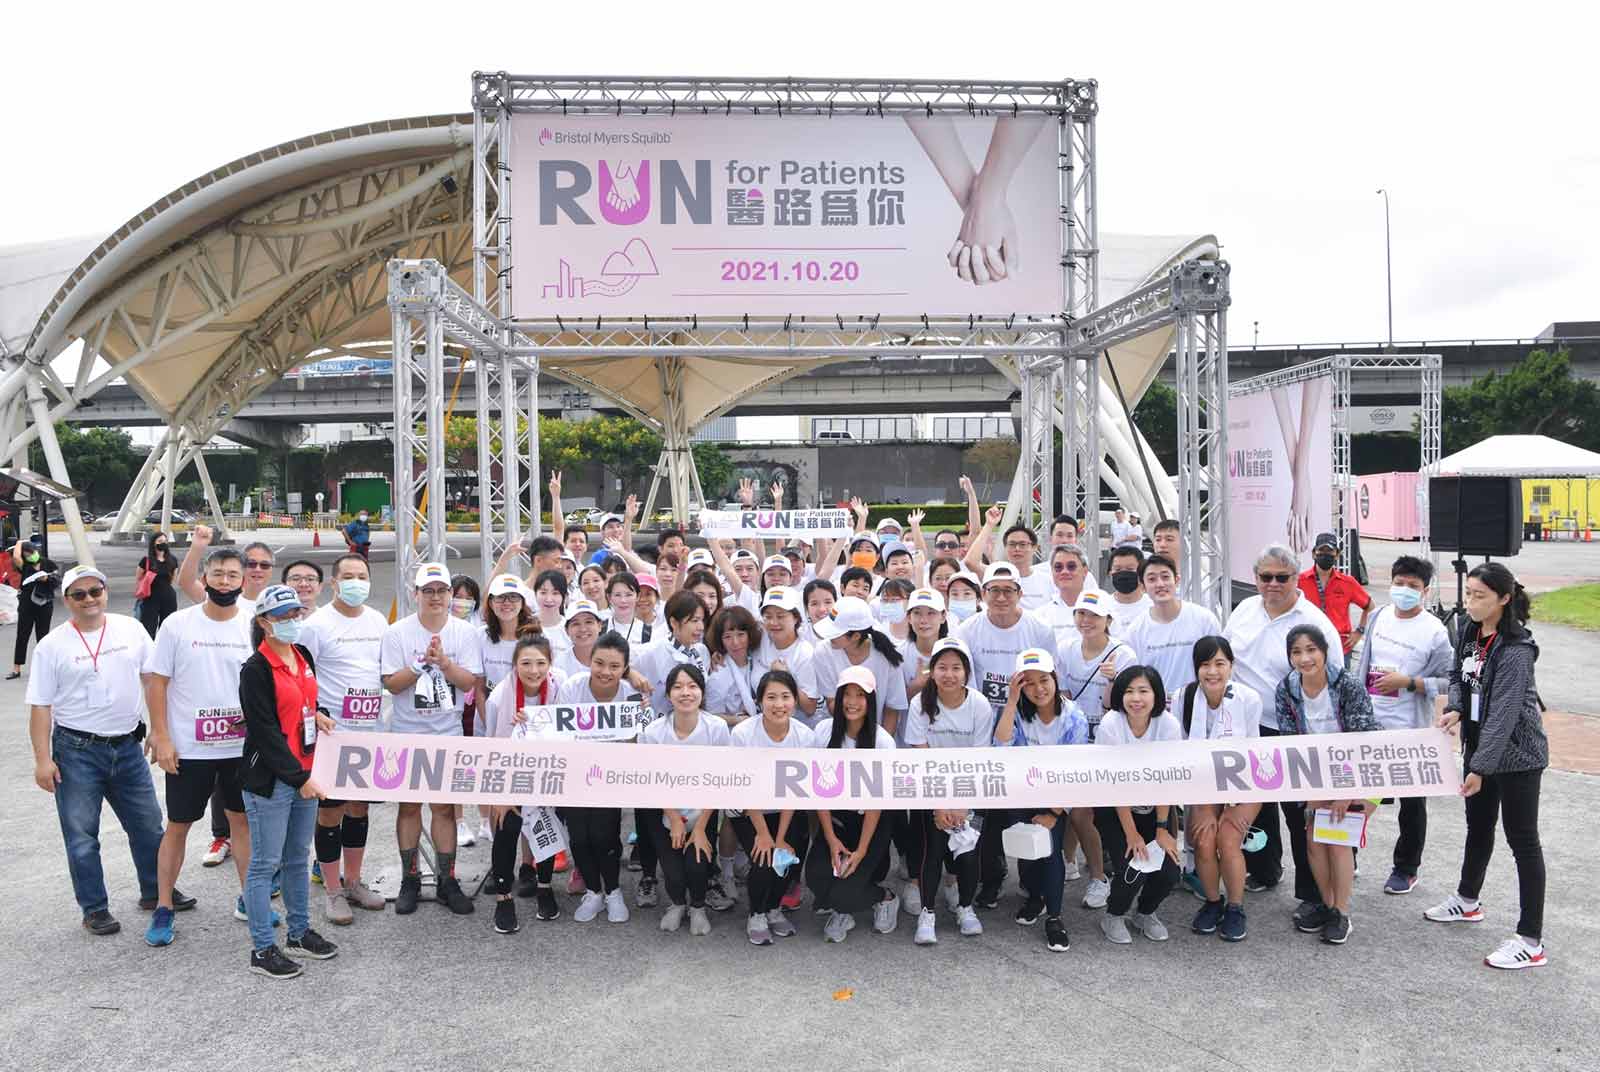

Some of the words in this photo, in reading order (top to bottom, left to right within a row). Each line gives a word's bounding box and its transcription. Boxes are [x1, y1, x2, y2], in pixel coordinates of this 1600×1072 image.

[555, 131, 591, 144] Bristol
[594, 132, 630, 146] Myers
[631, 131, 671, 146] Squibb
[539, 160, 711, 225] RUN
[726, 160, 770, 184] for
[780, 160, 905, 185] Patients
[721, 261, 859, 281] 2021.10.20
[741, 511, 790, 528] RUN
[986, 672, 1006, 682] RUN
[348, 687, 368, 696] RUN
[989, 683, 1009, 697] 31
[199, 708, 221, 718] RUN
[349, 698, 380, 713] 002
[556, 705, 616, 731] RUN
[620, 704, 634, 713] for
[202, 719, 228, 735] 00
[335, 745, 447, 791] RUN
[454, 750, 483, 766] for
[487, 751, 567, 769] Patients
[1046, 768, 1092, 784] Bristol
[1096, 768, 1140, 784] Myers
[1143, 766, 1192, 783] Squibb
[1211, 747, 1324, 792] RUN
[1327, 746, 1354, 762] for
[1360, 743, 1438, 761] Patients
[606, 770, 651, 785] Bristol
[655, 771, 699, 788] Myers
[703, 772, 752, 788] Squibb
[774, 760, 884, 798] RUN
[891, 760, 919, 774] for
[925, 759, 1005, 774] Patients
